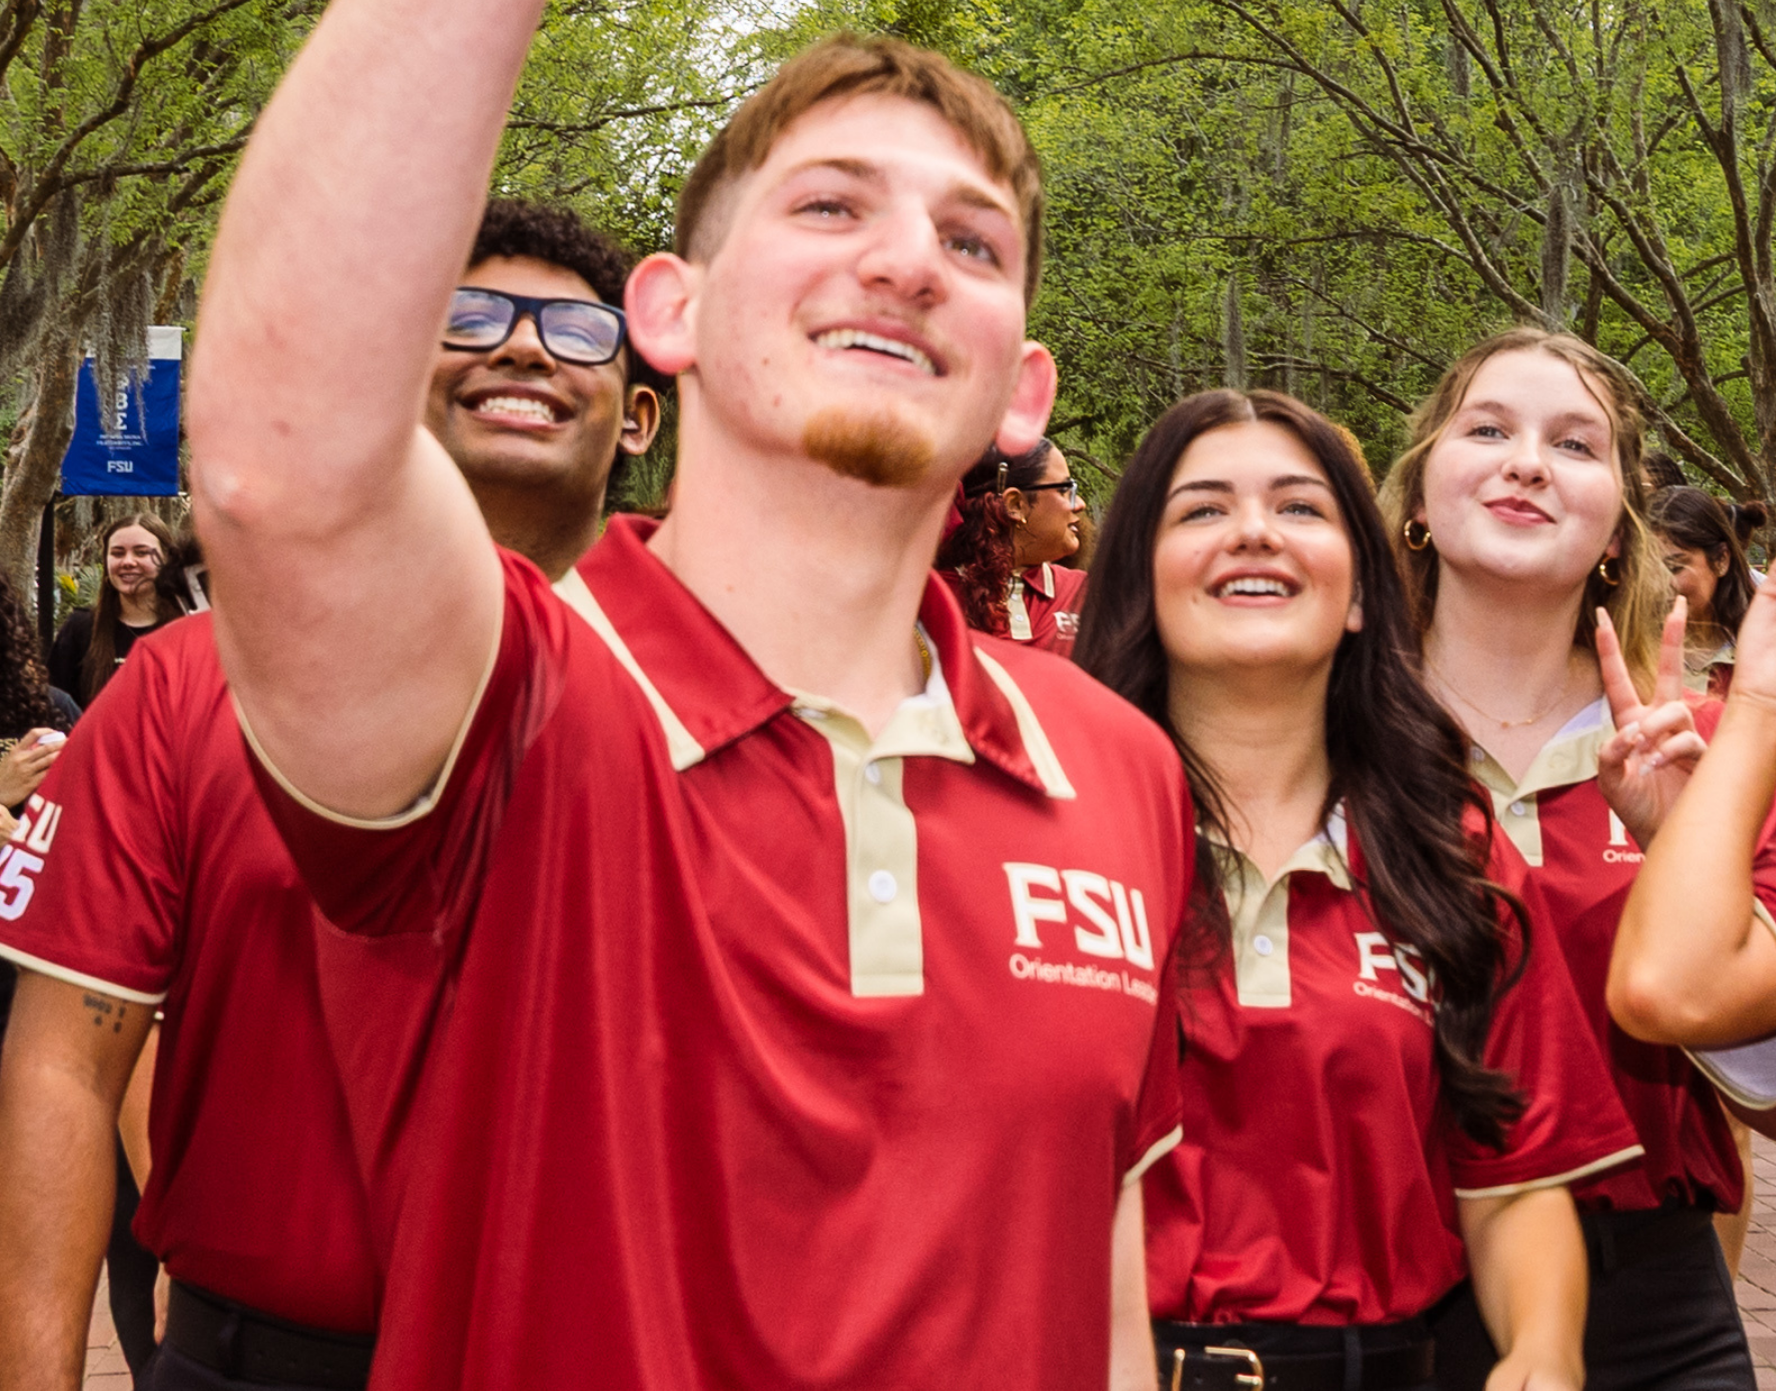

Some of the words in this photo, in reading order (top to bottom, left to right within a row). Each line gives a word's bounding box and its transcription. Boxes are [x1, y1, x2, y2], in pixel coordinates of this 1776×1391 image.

[107, 460, 134, 473] FSU
[0, 844, 45, 921] 5
[1002, 861, 1155, 971] FSU
[1009, 953, 1122, 991] Orientation
[1353, 931, 1440, 1012] FS
